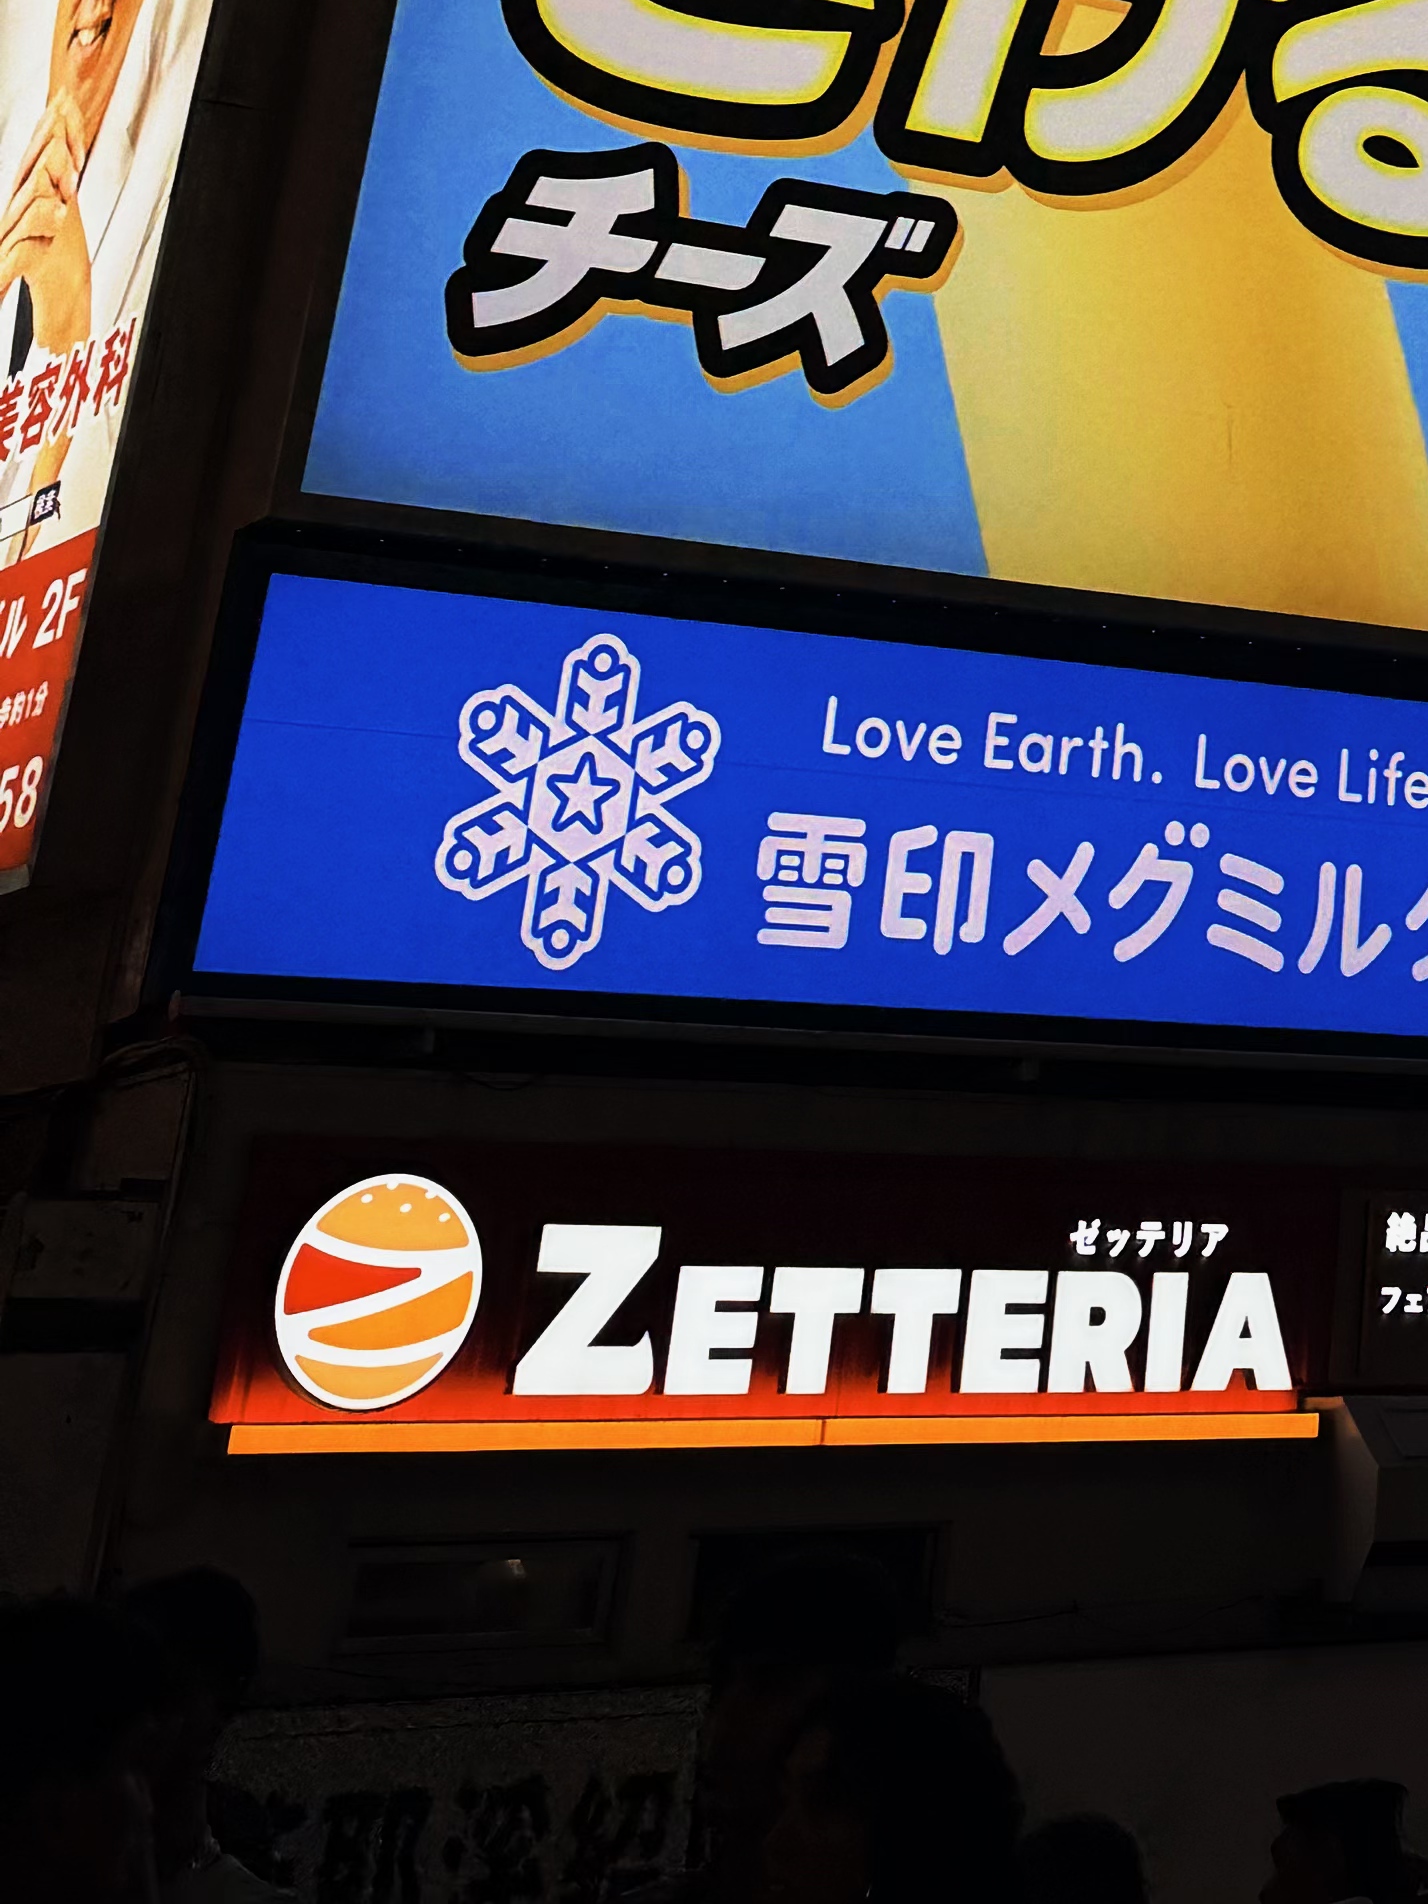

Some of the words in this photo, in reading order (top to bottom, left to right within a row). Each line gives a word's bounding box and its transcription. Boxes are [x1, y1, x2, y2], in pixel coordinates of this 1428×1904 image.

[468, 166, 938, 368] チーズ
[32, 567, 88, 650] 2F
[821, 695, 962, 768] Love
[984, 711, 1164, 786] Earth.
[1194, 735, 1320, 800] Love
[1069, 1218, 1229, 1262] ゼッテリア
[511, 1222, 1293, 1397] ZETTERIA
